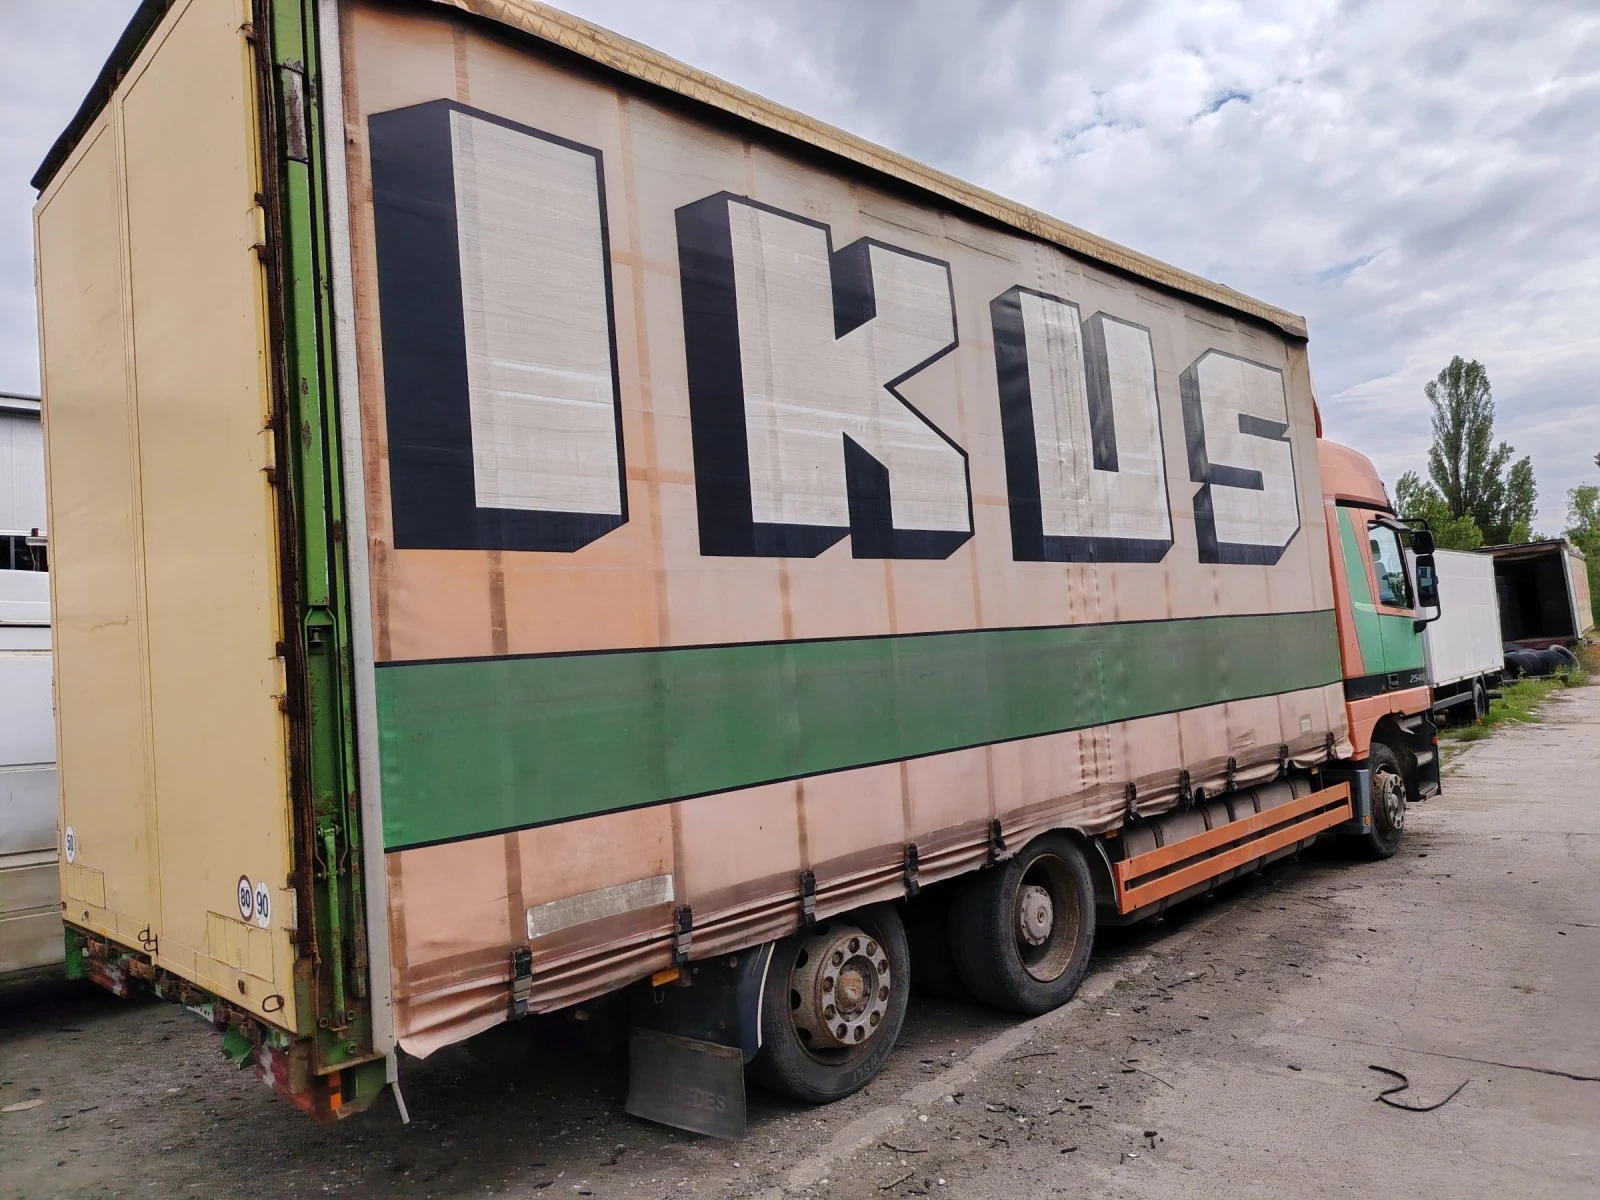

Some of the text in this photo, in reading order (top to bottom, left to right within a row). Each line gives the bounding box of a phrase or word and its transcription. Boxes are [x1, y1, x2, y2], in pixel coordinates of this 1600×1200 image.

[66, 833, 74, 852] 50
[240, 887, 251, 909] 80
[256, 891, 269, 918] 90
